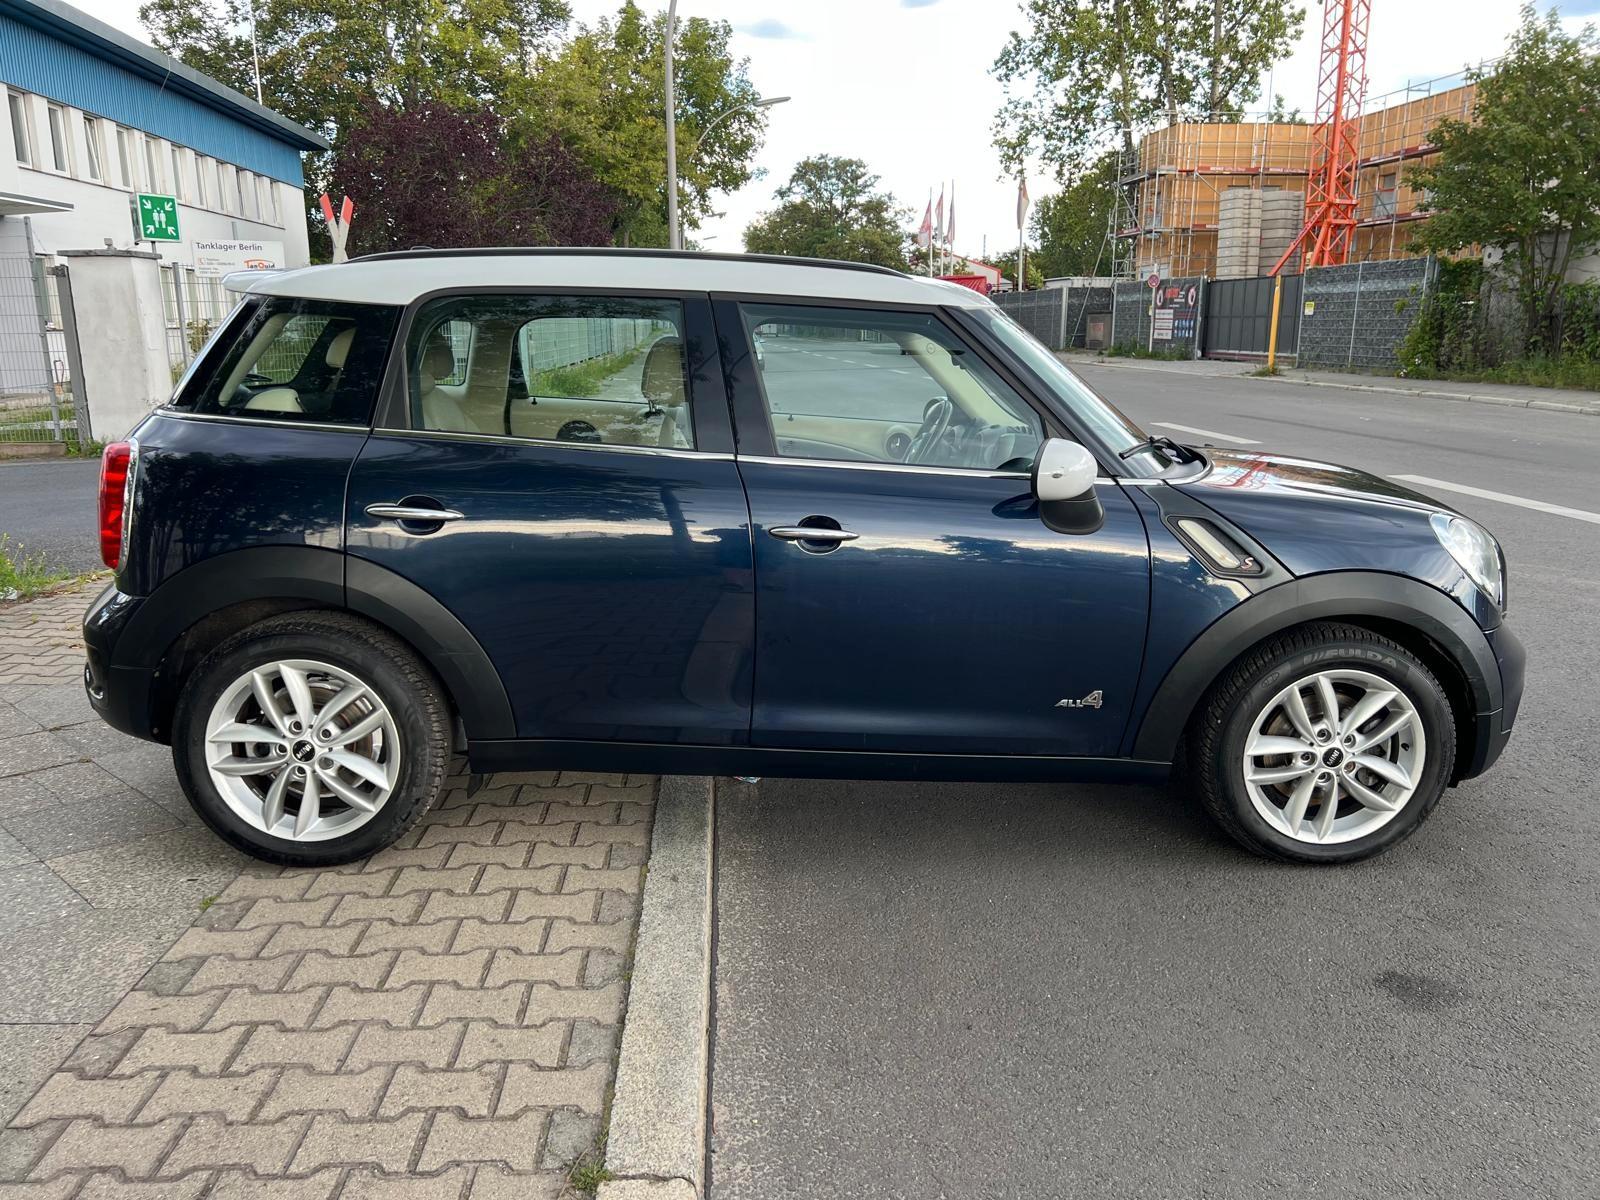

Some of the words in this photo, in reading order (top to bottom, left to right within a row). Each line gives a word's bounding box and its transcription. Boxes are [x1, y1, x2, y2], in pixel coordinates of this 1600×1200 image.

[196, 242, 237, 251] Tanklager
[239, 243, 263, 251] Berlin
[1324, 648, 1397, 669] FULDA
